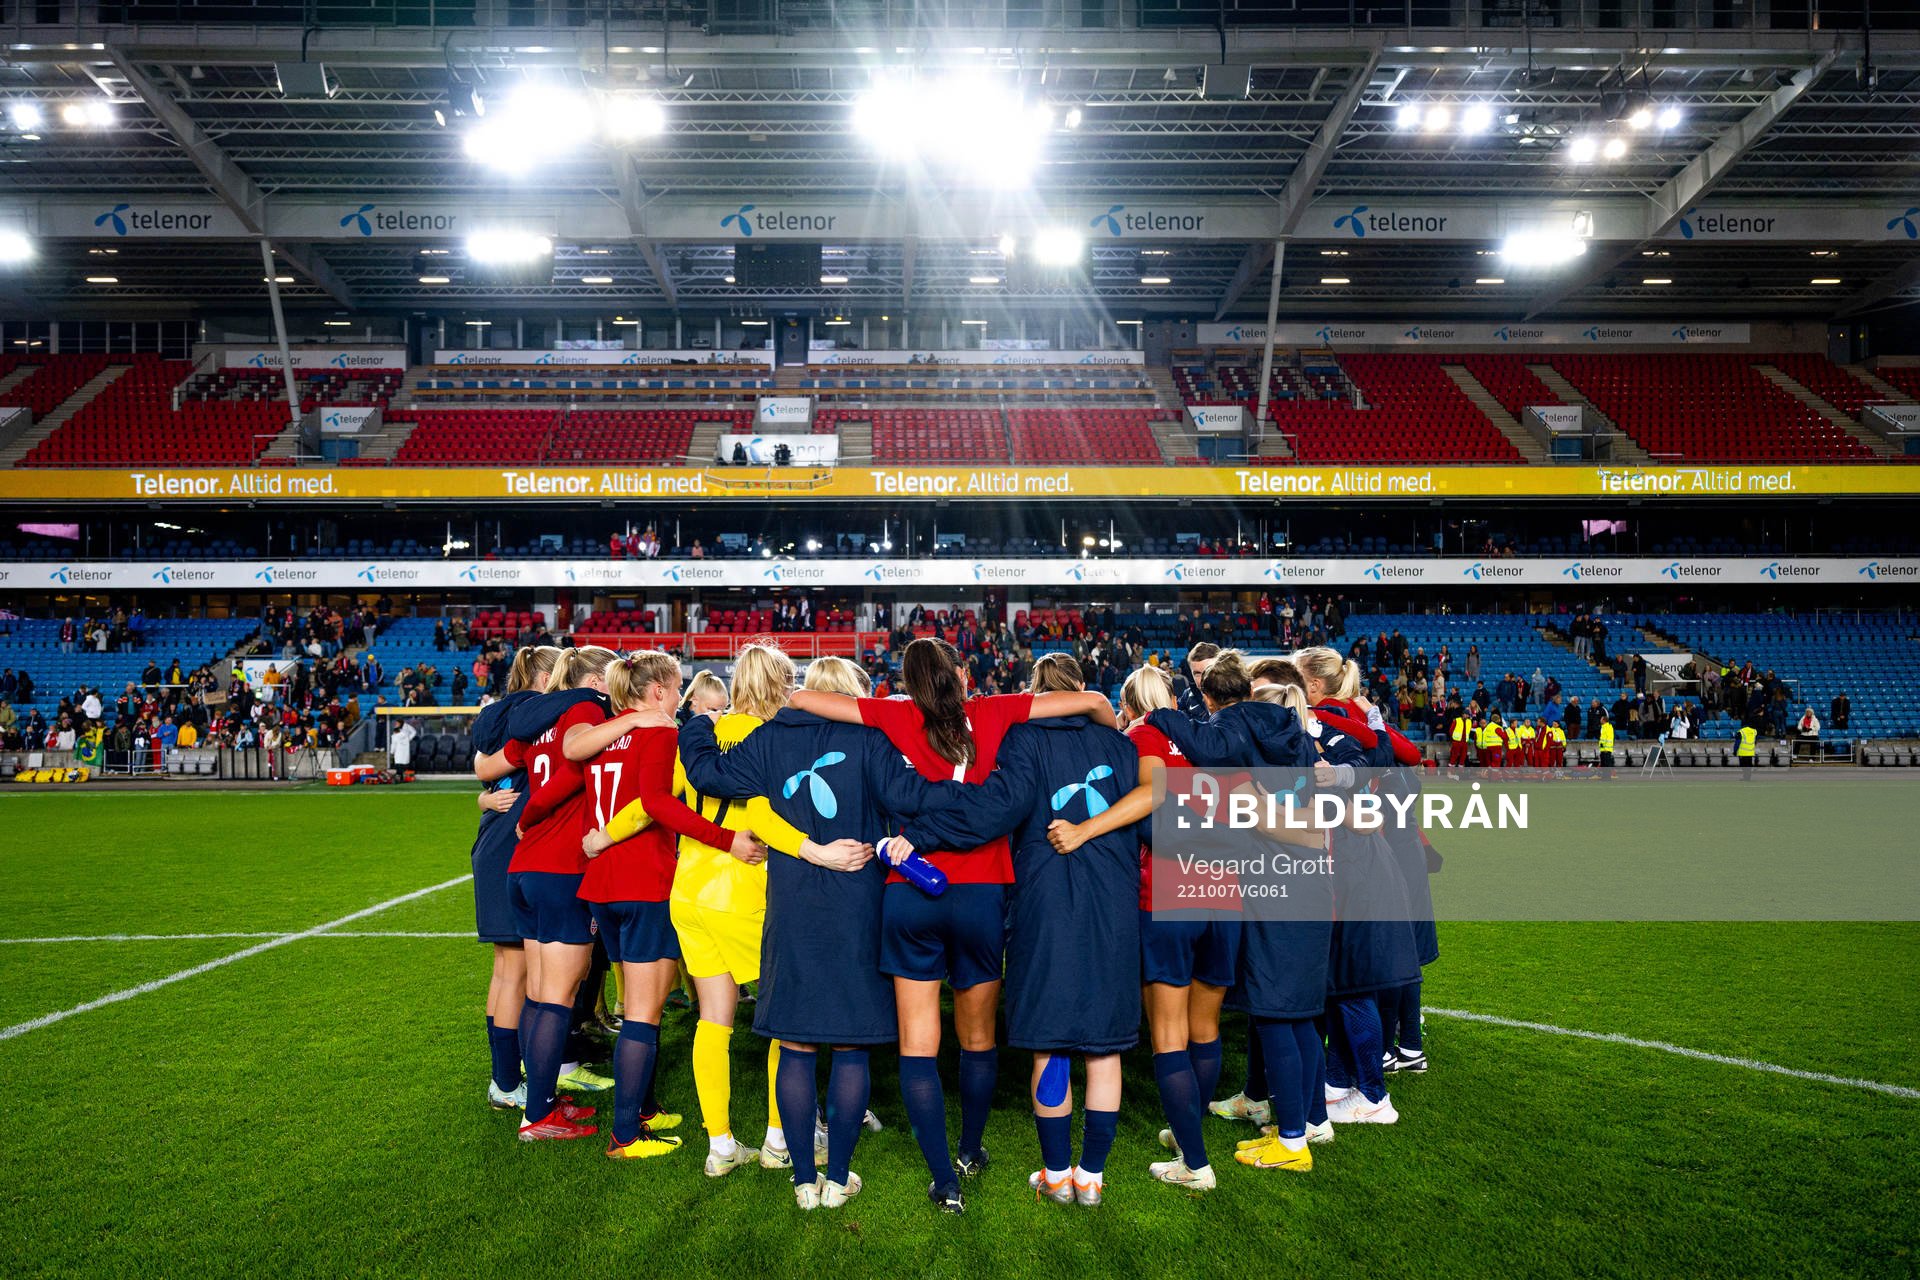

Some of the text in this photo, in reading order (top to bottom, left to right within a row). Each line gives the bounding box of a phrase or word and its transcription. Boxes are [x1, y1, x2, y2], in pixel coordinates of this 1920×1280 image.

[131, 211, 212, 230] telenor
[376, 210, 456, 230] telenor
[756, 211, 836, 230] telenor
[1126, 211, 1204, 230] telenor
[1369, 212, 1447, 231] telenor
[1697, 213, 1776, 232] telenor
[1330, 329, 1365, 338] telenor
[1419, 328, 1455, 338] telenor
[1509, 328, 1544, 338] telenor
[1598, 328, 1633, 338] telenor
[1686, 328, 1722, 338] telenor
[264, 355, 302, 366] teleor
[347, 355, 384, 365] telenor
[1205, 413, 1238, 422] telenor
[1545, 414, 1577, 422] telenor
[130, 474, 338, 494] Telenor. Alltid med.
[502, 473, 708, 493] Telenor. Alltid med.
[870, 472, 1074, 493] Telenor. Alltid med.
[1236, 472, 1436, 492] Telenor. Alltid med.
[1598, 471, 1796, 491] Telenor. Alltid med.
[68, 570, 112, 580] telenor
[171, 570, 215, 580] telenor
[273, 569, 317, 580] telenor
[375, 569, 419, 579] telenor
[477, 569, 520, 579] telenor
[681, 568, 724, 578] telenor
[782, 568, 825, 578] telenor
[1183, 567, 1226, 577] telenor
[1282, 566, 1325, 577] telenor
[1381, 566, 1424, 577] telenor
[1481, 566, 1523, 576] telenor
[1580, 566, 1622, 576] telenor
[1679, 565, 1721, 576] telenor
[1778, 565, 1820, 576] telenor
[1876, 565, 1918, 575] telenor
[591, 763, 624, 831] 17
